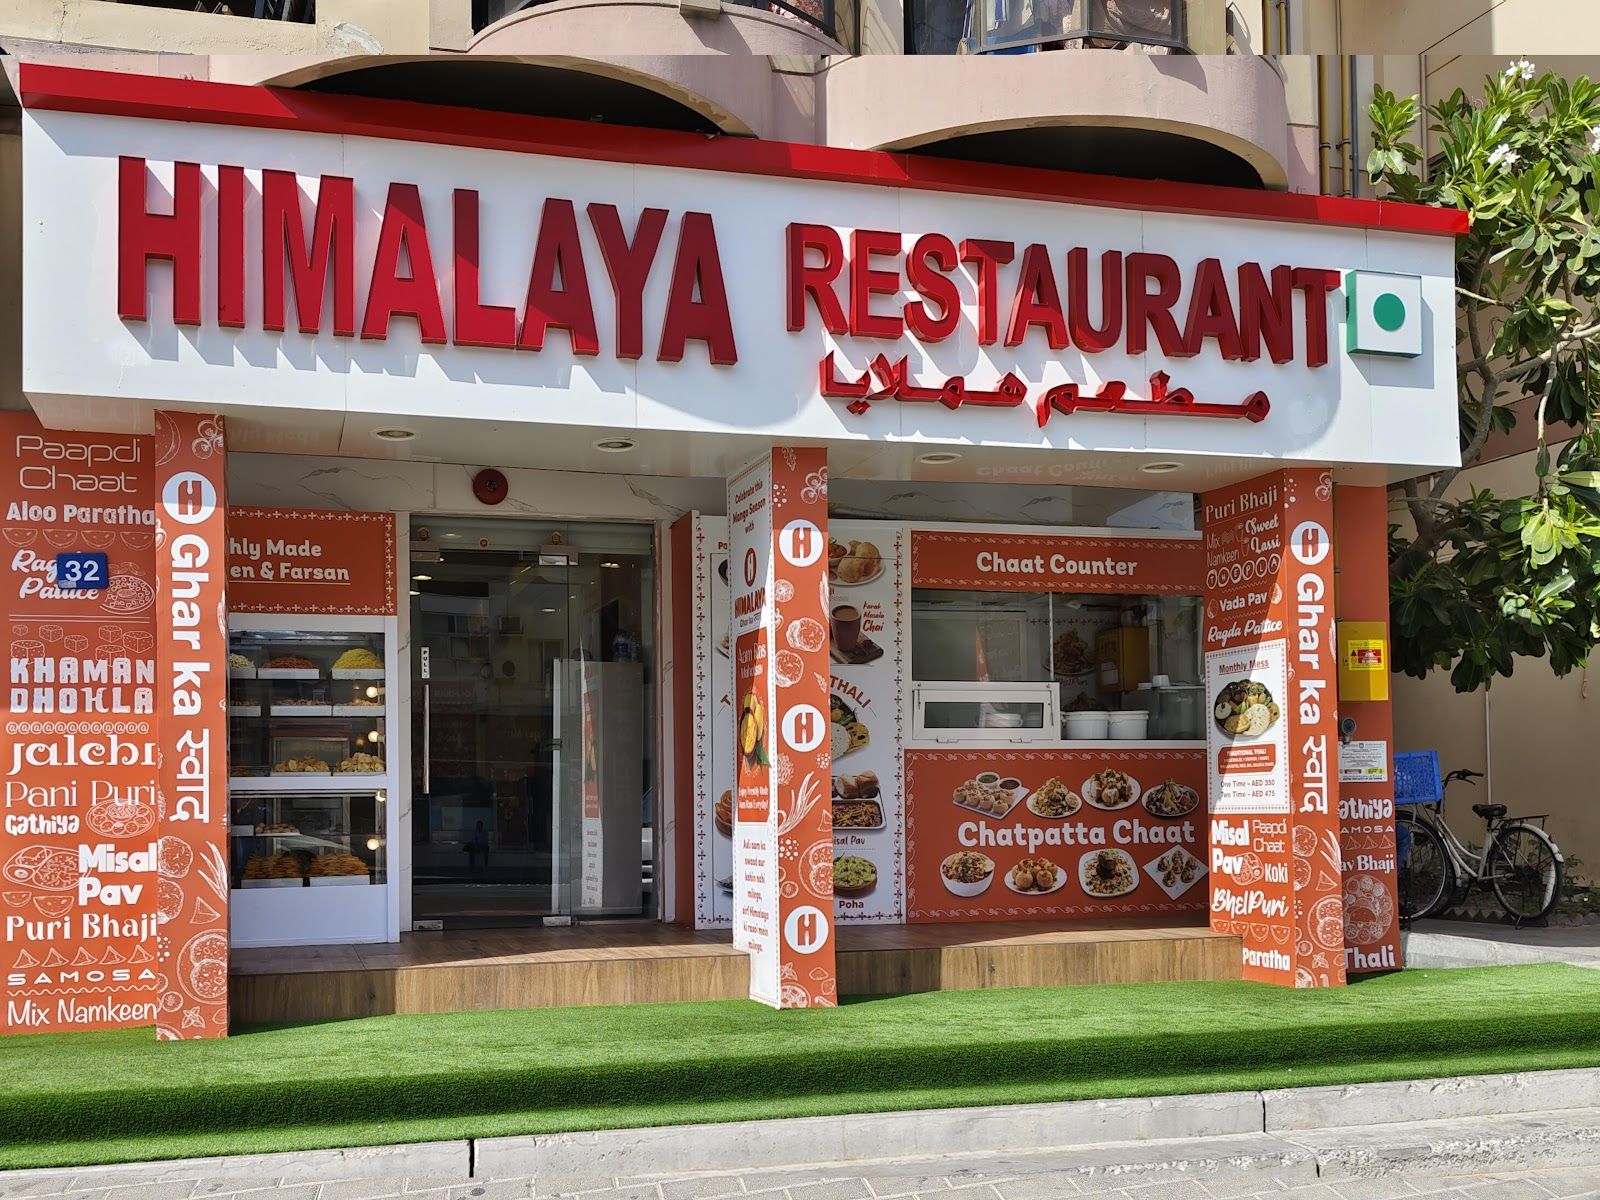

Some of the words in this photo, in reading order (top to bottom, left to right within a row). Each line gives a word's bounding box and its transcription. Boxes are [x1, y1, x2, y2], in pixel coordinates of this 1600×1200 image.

[118, 156, 737, 366] HIMALAYA
[786, 223, 1340, 368] RESTAURANT
[1038, 369, 1271, 427] مطعم
[16, 435, 141, 467] Paapdi
[20, 466, 137, 492] Chaat
[6, 500, 57, 522] Aloo
[63, 504, 155, 526] Paratha
[1205, 501, 1236, 523] Puri
[1240, 485, 1278, 513] Bhaji
[1245, 513, 1279, 535] Sweet
[230, 537, 260, 560] hly
[266, 539, 322, 556] Made
[1207, 532, 1220, 550] Mix
[1250, 533, 1281, 554] Lassi
[11, 549, 57, 583] Rag
[65, 560, 100, 582] 32
[230, 565, 255, 578] en
[260, 561, 274, 580] &
[280, 562, 349, 580] Farsan
[976, 552, 1044, 573] Chaat
[1050, 554, 1137, 576] Counter
[1207, 548, 1240, 568] Namkeen
[1207, 554, 1280, 588] THEPLA
[171, 534, 209, 650] Ghar
[1219, 597, 1245, 612] Vada
[1248, 592, 1267, 606] Pav
[862, 619, 884, 632] Chai
[1208, 623, 1241, 648] Ragda
[1244, 617, 1283, 637] Pattice
[1297, 573, 1324, 670] Ghar
[10, 657, 155, 684] KHAMAN
[1219, 661, 1247, 673] Monthly
[1249, 659, 1269, 669] Mess
[10, 687, 154, 714] DHOKLA
[173, 662, 209, 716] ka
[829, 674, 871, 708] THALI
[1300, 680, 1326, 724] ka
[6, 782, 77, 807] Pani
[91, 780, 155, 806] Puri
[1339, 798, 1393, 820] athiya
[833, 836, 848, 845] isal
[851, 836, 865, 845] Pav
[958, 820, 1106, 854] Chatpatta
[1112, 818, 1195, 844] Chaat
[1212, 819, 1250, 846] Misal
[1252, 818, 1287, 838] Paapdi
[1341, 825, 1394, 833] AMOSA
[1253, 837, 1286, 853] Chaat
[78, 844, 157, 873] Misal
[1212, 848, 1243, 875] Pav
[1340, 861, 1354, 872] av
[1357, 854, 1394, 874] Bhaji
[1265, 862, 1288, 883] Koki
[78, 877, 143, 906] Pav
[839, 901, 864, 909] Poha
[6, 915, 70, 941] Puri
[83, 913, 156, 937] Bhaji
[1243, 947, 1290, 971] Paratha
[1344, 944, 1395, 969] Thali
[7, 968, 155, 985] SAMOSA
[7, 1000, 50, 1026] Mix
[58, 997, 157, 1024] Namkeen
